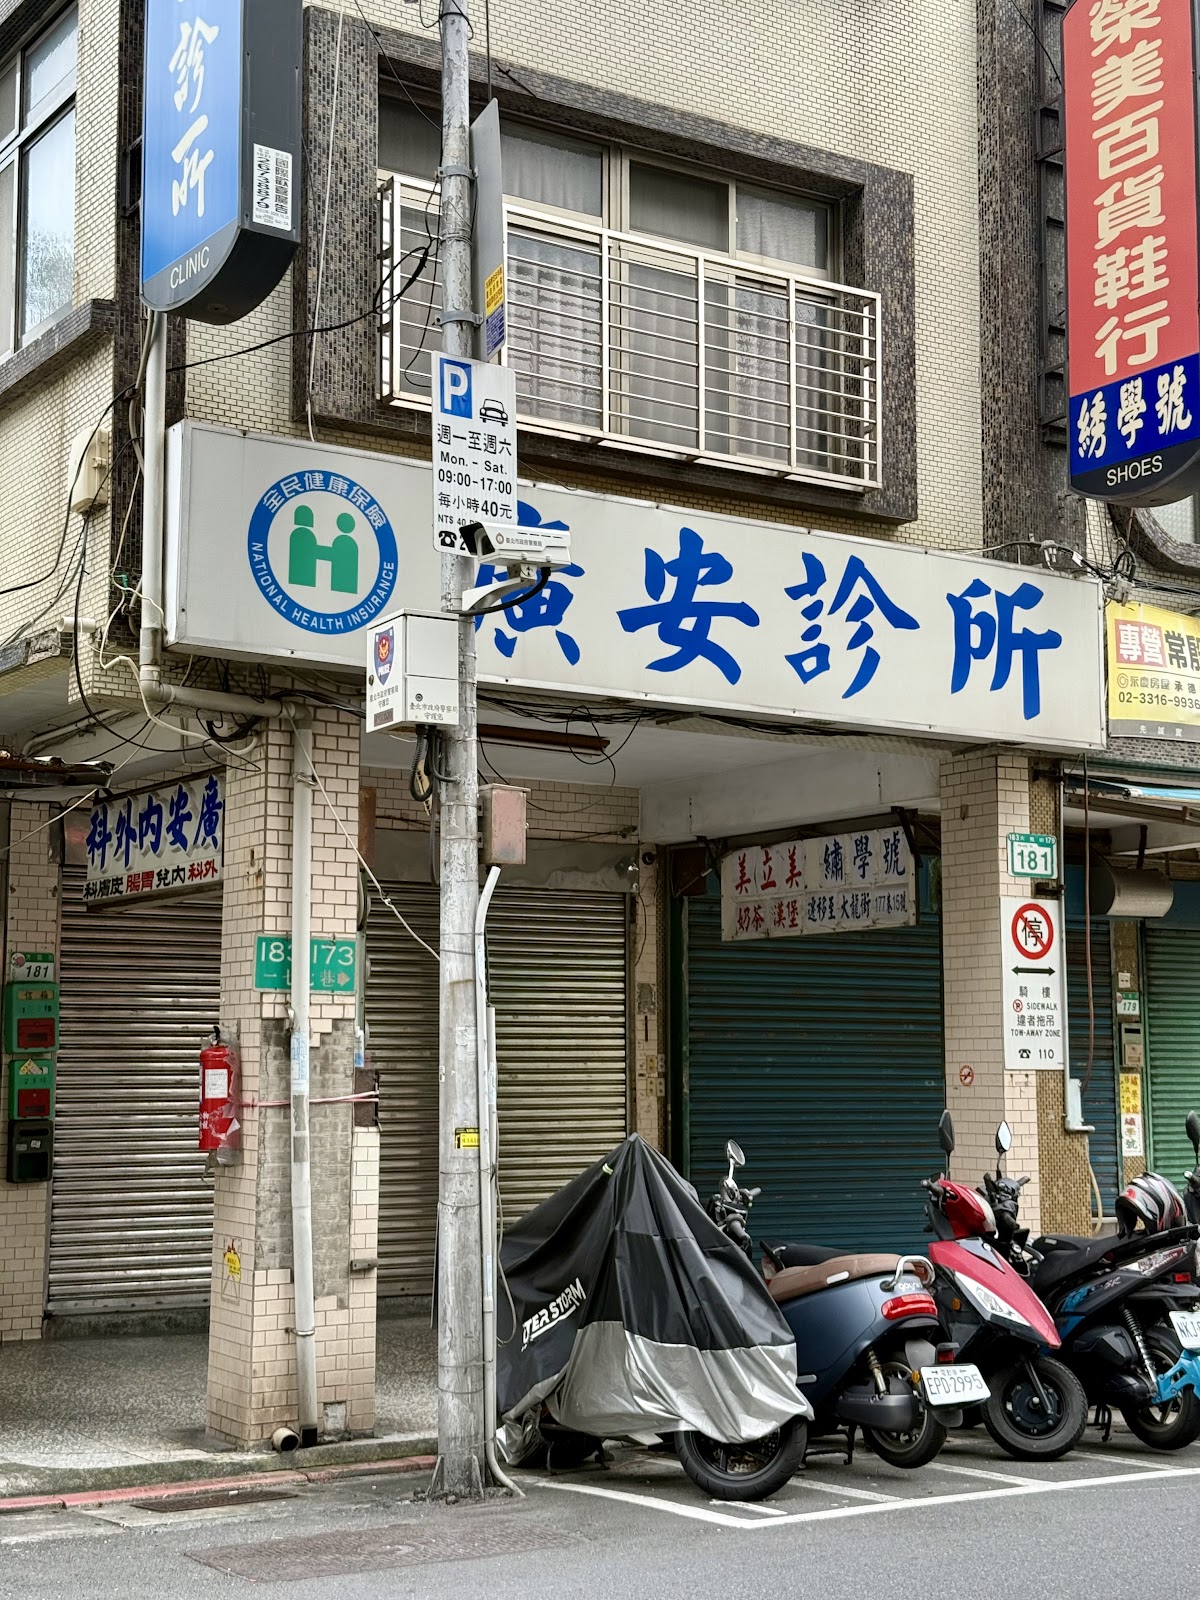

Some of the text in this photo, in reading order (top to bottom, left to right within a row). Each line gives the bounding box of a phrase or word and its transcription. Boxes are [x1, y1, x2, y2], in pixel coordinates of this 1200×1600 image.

[170, 246, 210, 289] CLINIC
[442, 362, 468, 410] P
[437, 422, 512, 457] 週一至週六
[440, 450, 468, 467] Mon.
[484, 460, 508, 475] Sat.
[1106, 454, 1163, 487] SHOES
[437, 468, 512, 495] 09:00-17:00
[262, 472, 387, 530] 全民健康保險
[437, 491, 513, 520] 每小時40元
[251, 542, 395, 630] NATIONAL HEALTH INSURANCE
[475, 500, 1063, 720] 廣安診所
[1118, 623, 1164, 665] 專營
[1118, 691, 1200, 710] 02-3316-9936
[1016, 849, 1048, 871] 181
[1021, 916, 1043, 947] 停
[313, 944, 354, 966] 173
[26, 964, 49, 978] 181
[1019, 985, 1051, 999] 騎樓
[1026, 1002, 1059, 1011] SIDEWALK
[1122, 1001, 1137, 1012] 179
[1011, 1028, 1061, 1037] TOW-AWAY ZONE
[1016, 1014, 1055, 1027] 違者拖吊
[1038, 1048, 1055, 1060] 110
